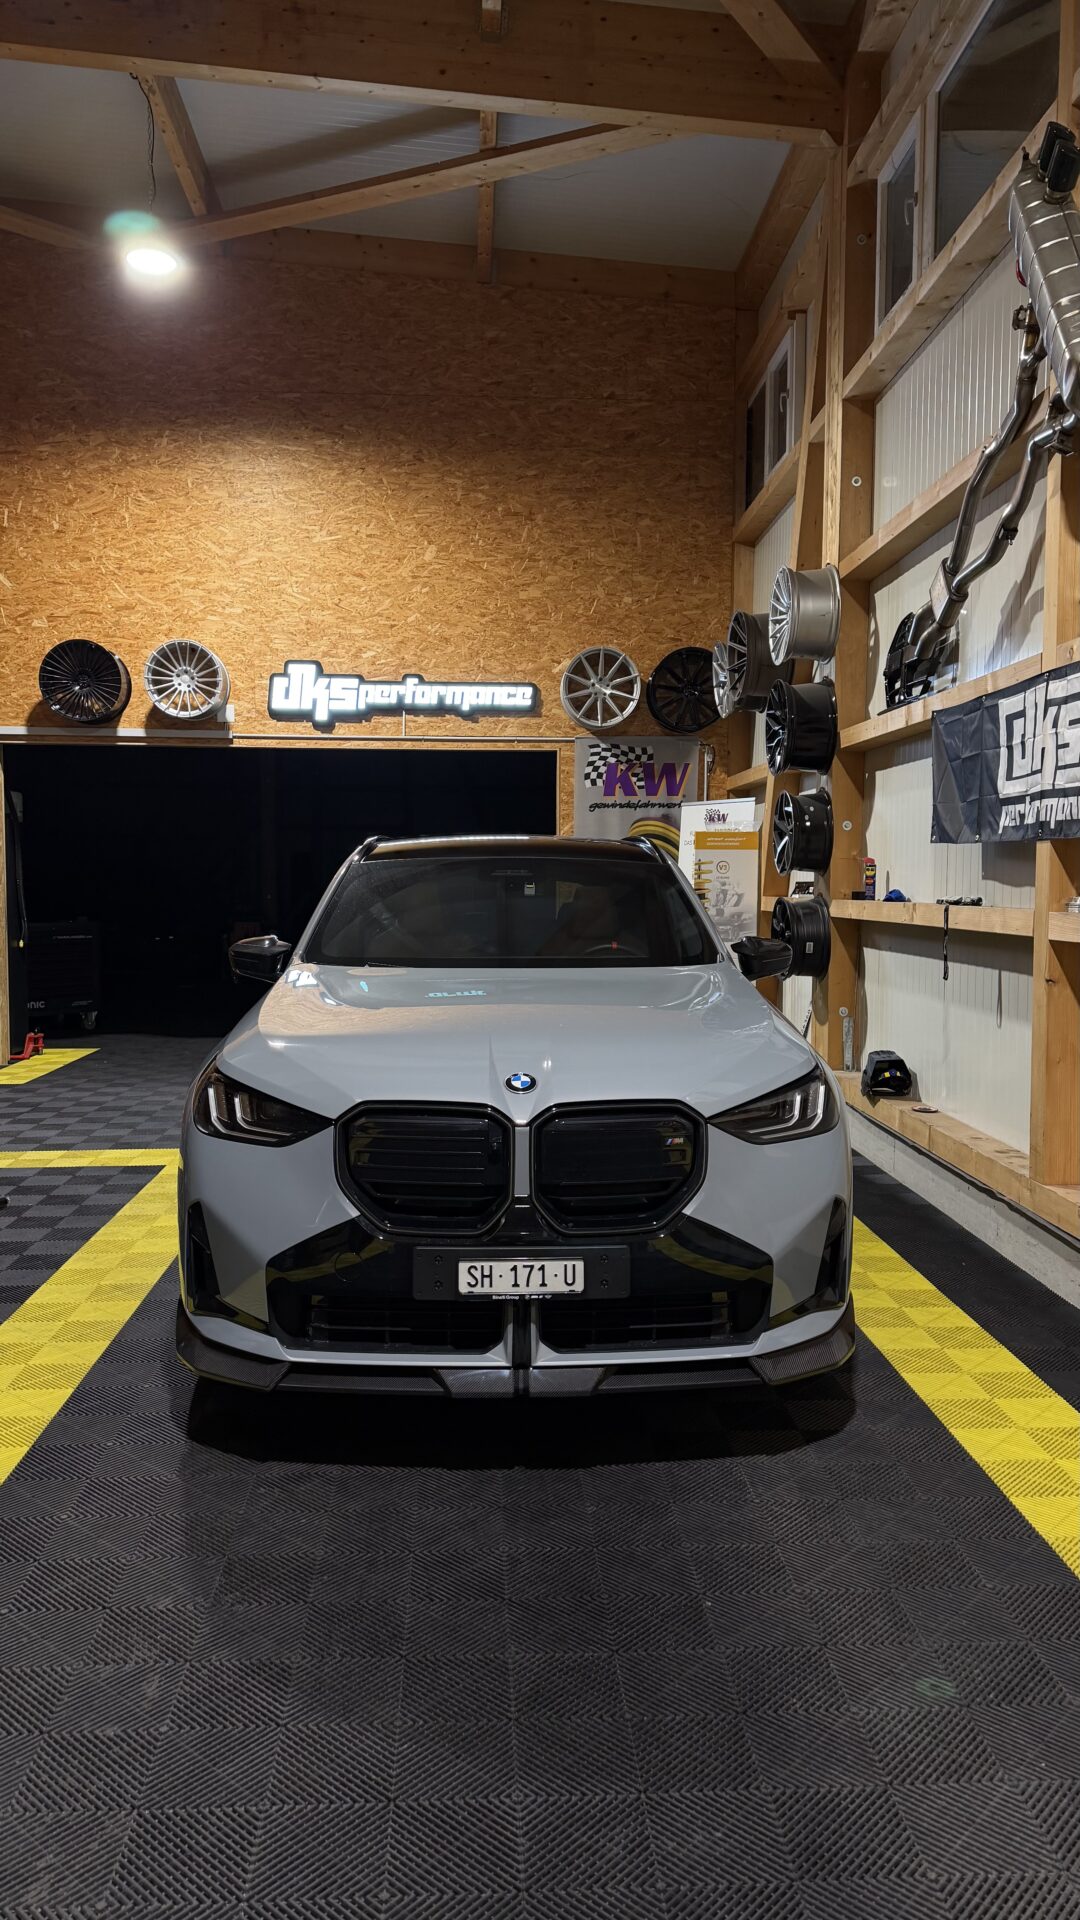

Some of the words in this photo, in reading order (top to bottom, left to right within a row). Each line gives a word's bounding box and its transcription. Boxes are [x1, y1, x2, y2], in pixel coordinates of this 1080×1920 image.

[603, 762, 690, 797] KW
[708, 813, 728, 823] KW
[998, 795, 1080, 834] performan
